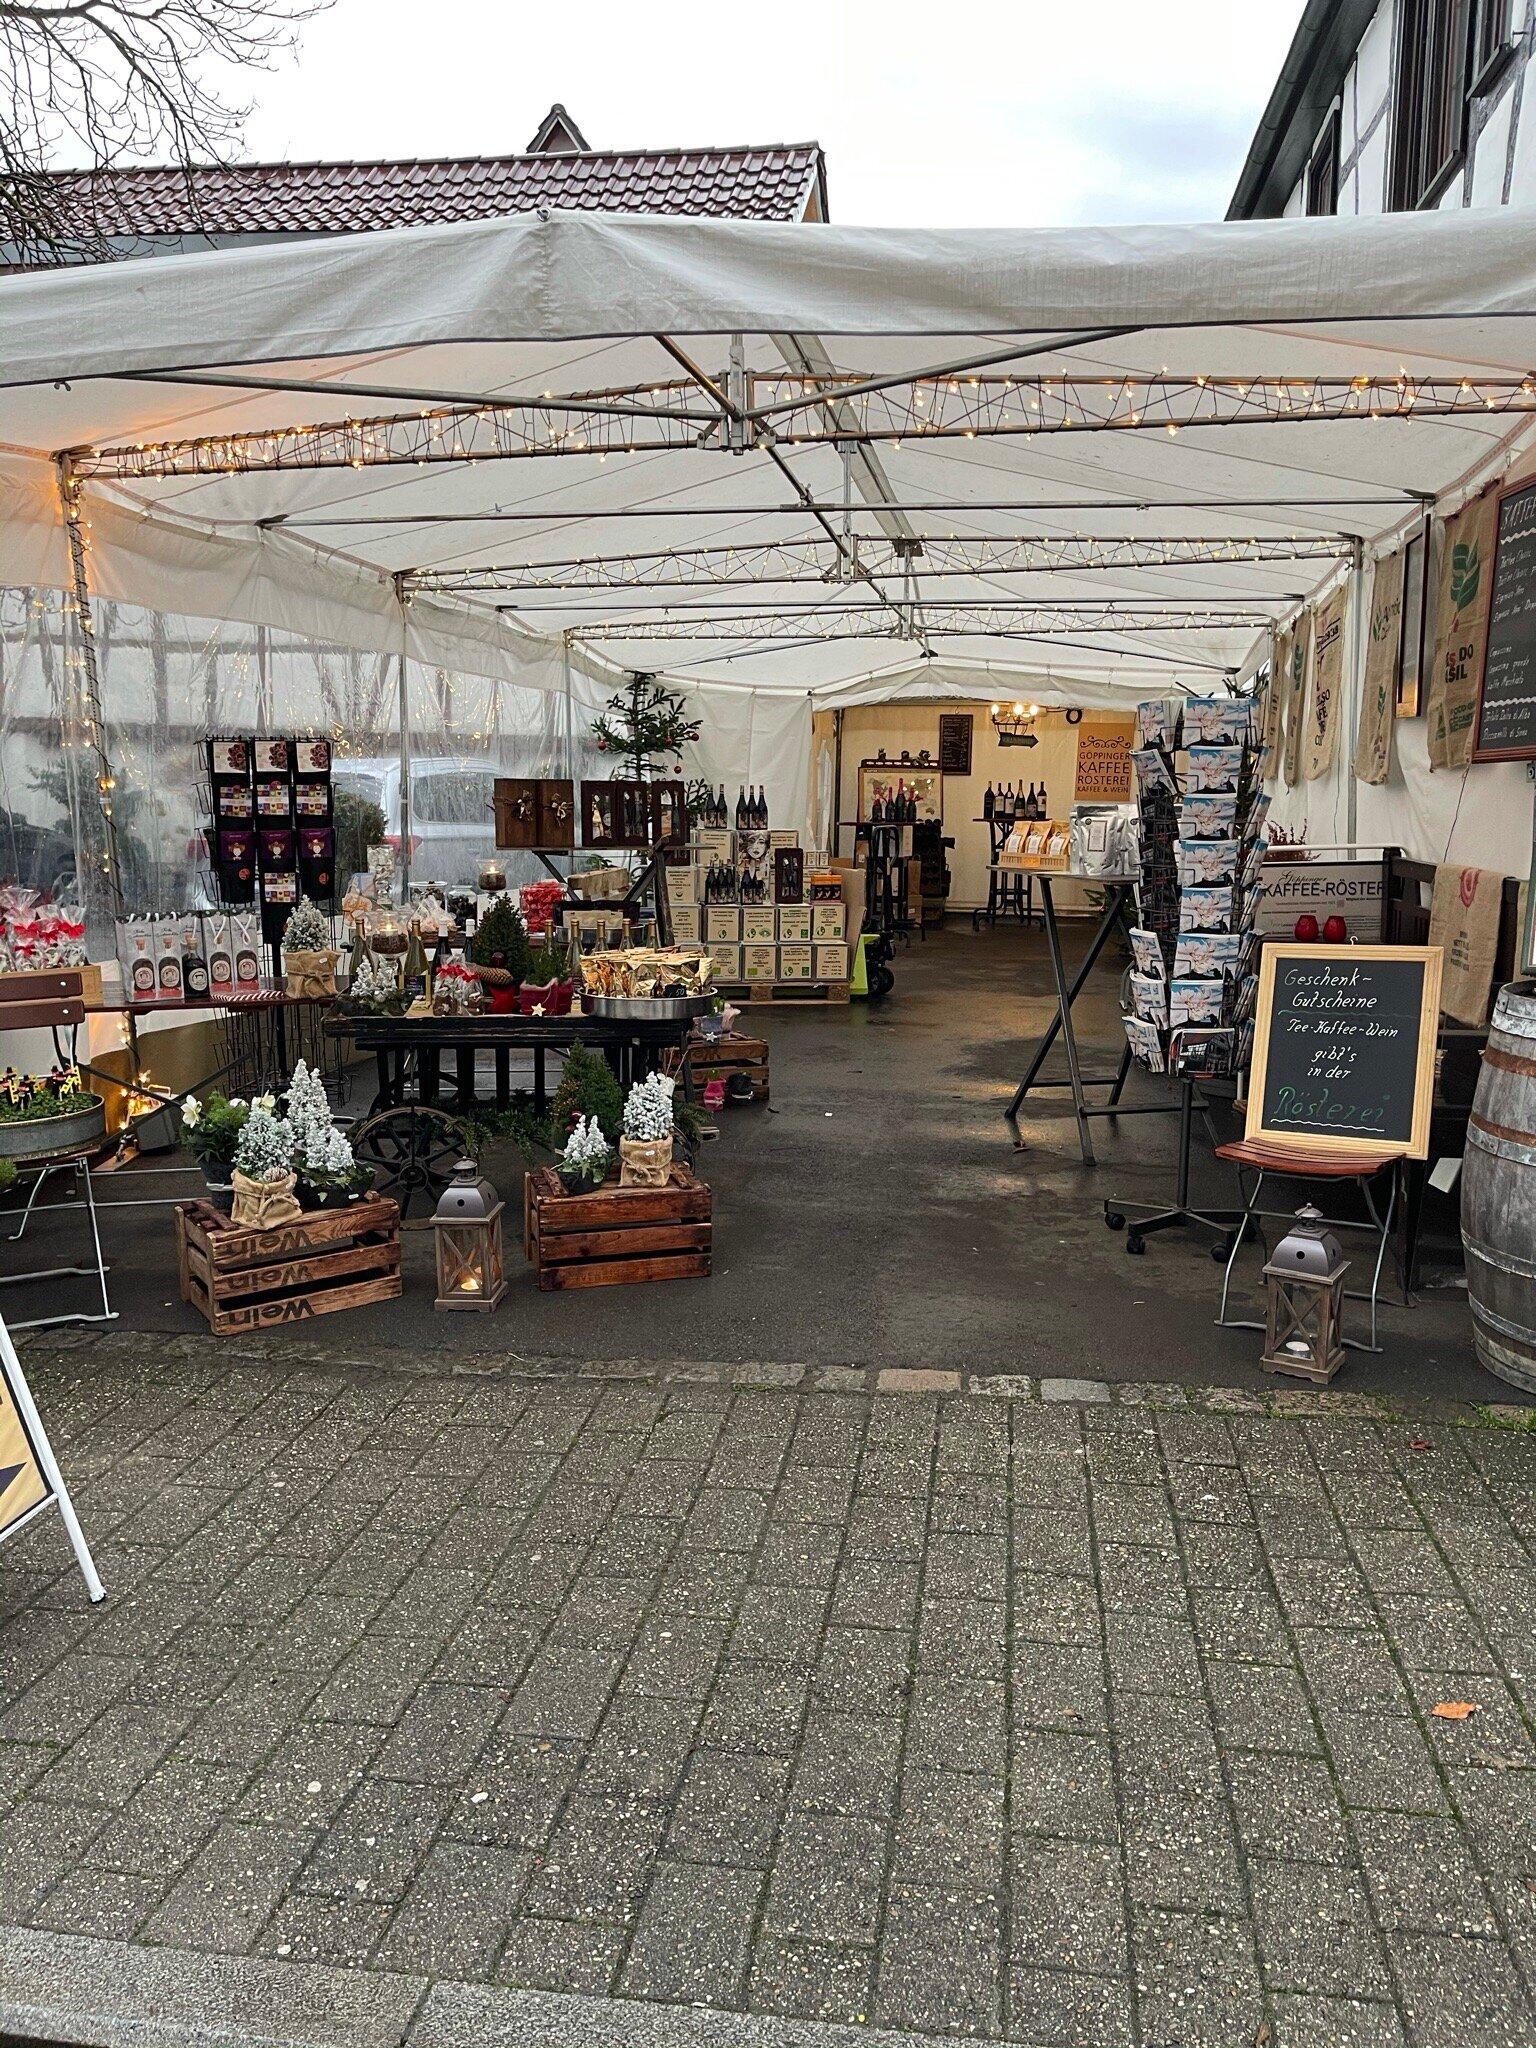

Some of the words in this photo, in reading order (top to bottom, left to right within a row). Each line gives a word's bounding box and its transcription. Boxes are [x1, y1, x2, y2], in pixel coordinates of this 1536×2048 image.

[1459, 644, 1474, 662] DO
[1078, 761, 1130, 774] KAFFEE
[1292, 990, 1378, 1008] Gutscheine
[1311, 1046, 1358, 1063] gibt's
[1306, 1065, 1322, 1077] in
[1325, 1065, 1351, 1079] der
[1274, 1086, 1391, 1123] Rösterei
[226, 1264, 314, 1292] Wein
[226, 1298, 316, 1327] Wein
